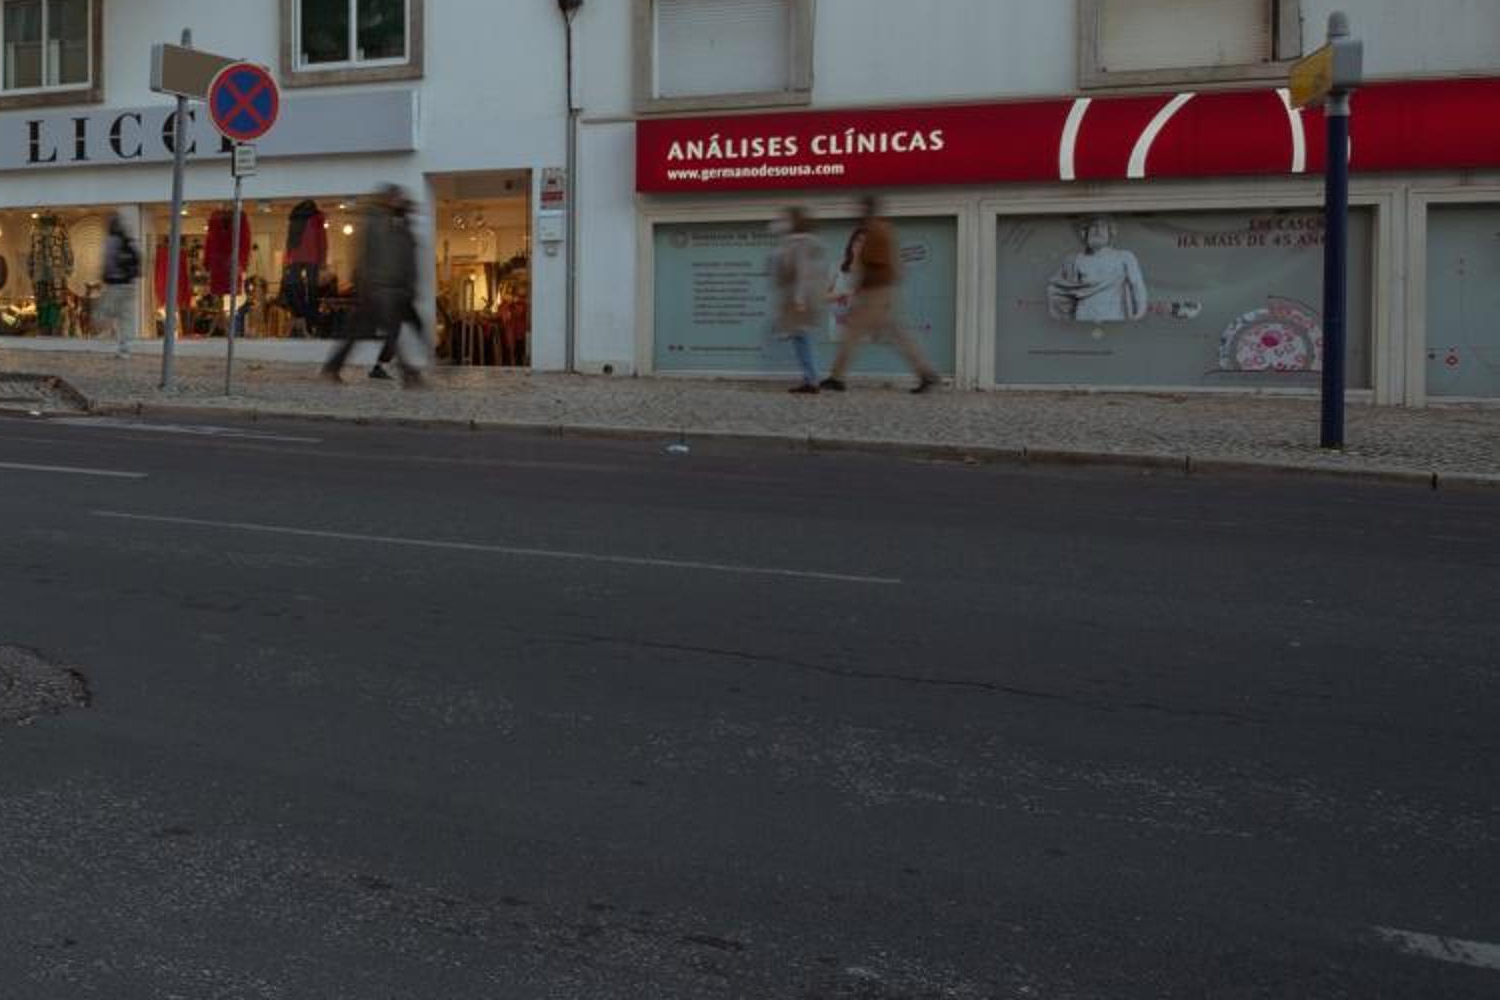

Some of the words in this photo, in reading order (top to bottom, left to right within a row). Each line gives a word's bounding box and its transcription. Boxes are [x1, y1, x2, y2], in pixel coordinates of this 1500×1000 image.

[26, 109, 235, 163] LICC
[667, 133, 798, 161] ANÁLISES
[811, 127, 944, 155] CLÍNICAS
[667, 163, 845, 182] www.germanodesousa.com
[1203, 233, 1243, 247] MAIS
[1247, 233, 1267, 247] DE
